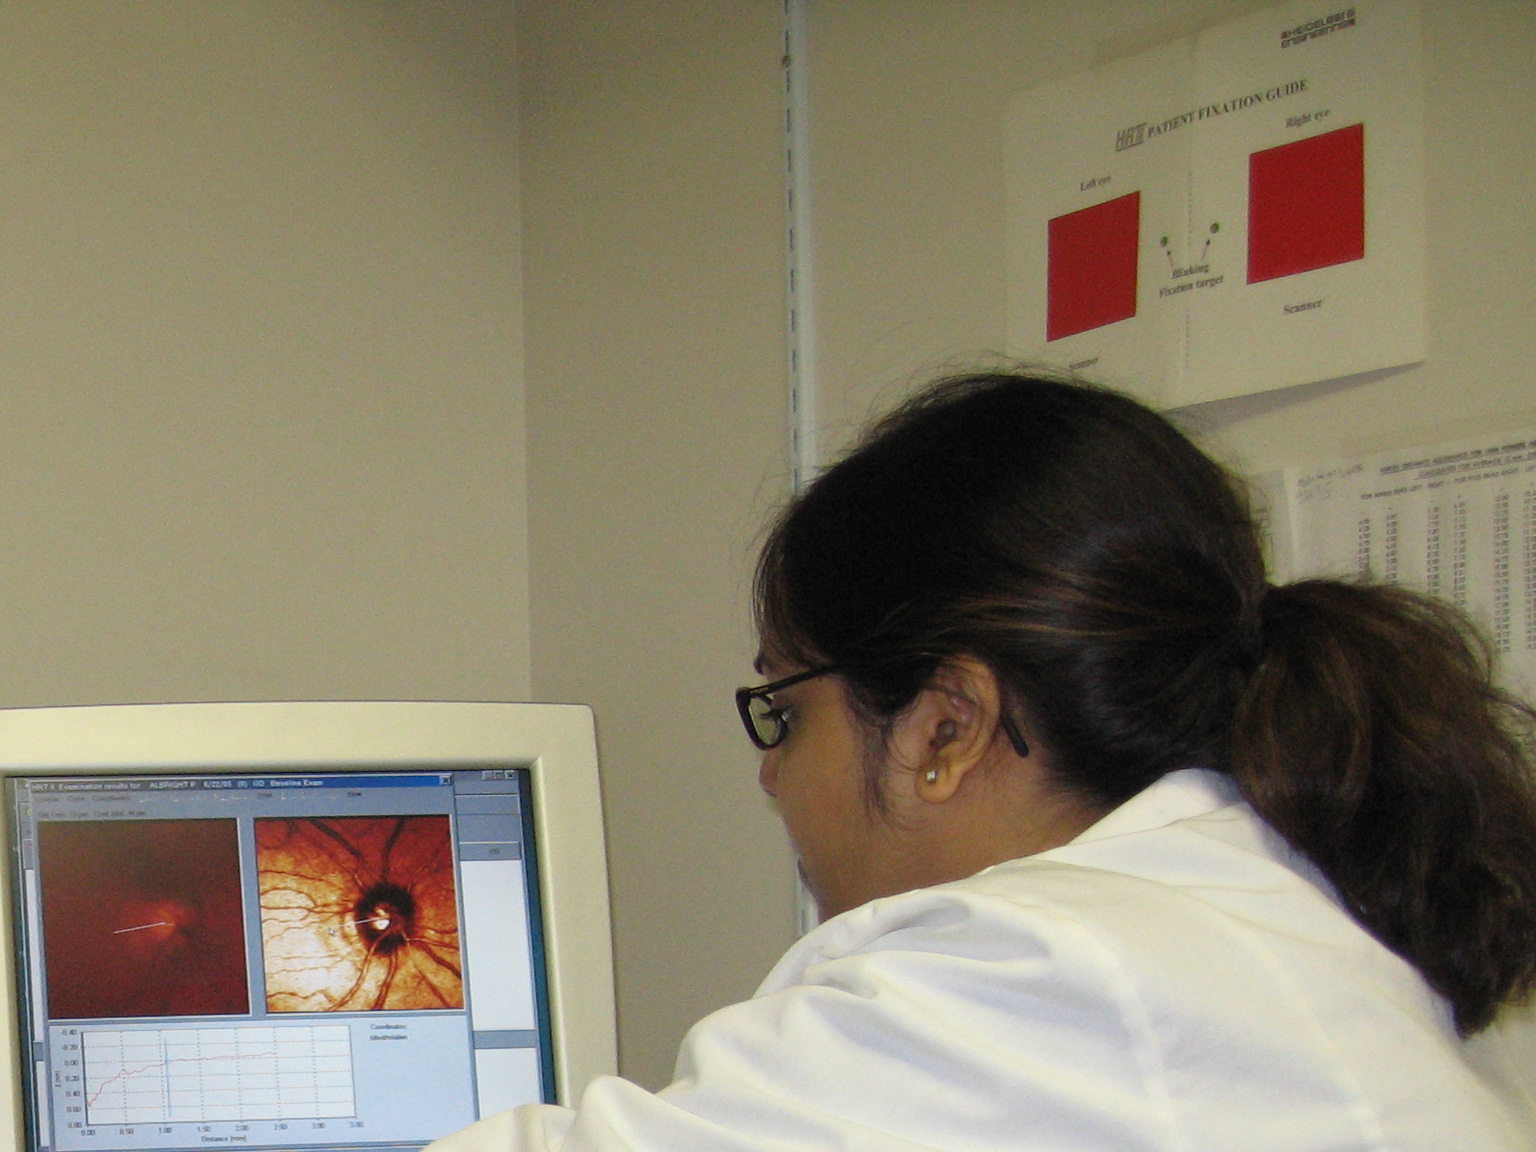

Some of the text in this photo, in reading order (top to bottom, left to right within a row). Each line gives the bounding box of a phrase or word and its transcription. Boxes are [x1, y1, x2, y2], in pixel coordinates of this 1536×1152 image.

[1148, 111, 1195, 138] PATIENT
[1198, 92, 1262, 120] FIXATION
[1266, 79, 1308, 101] GUIDE
[1286, 112, 1312, 128] Right
[1080, 178, 1096, 192] Left
[1159, 275, 1224, 299] Fixation target
[1283, 300, 1322, 315] Scanner
[270, 779, 302, 788] Baseline
[303, 778, 324, 787] Exam
